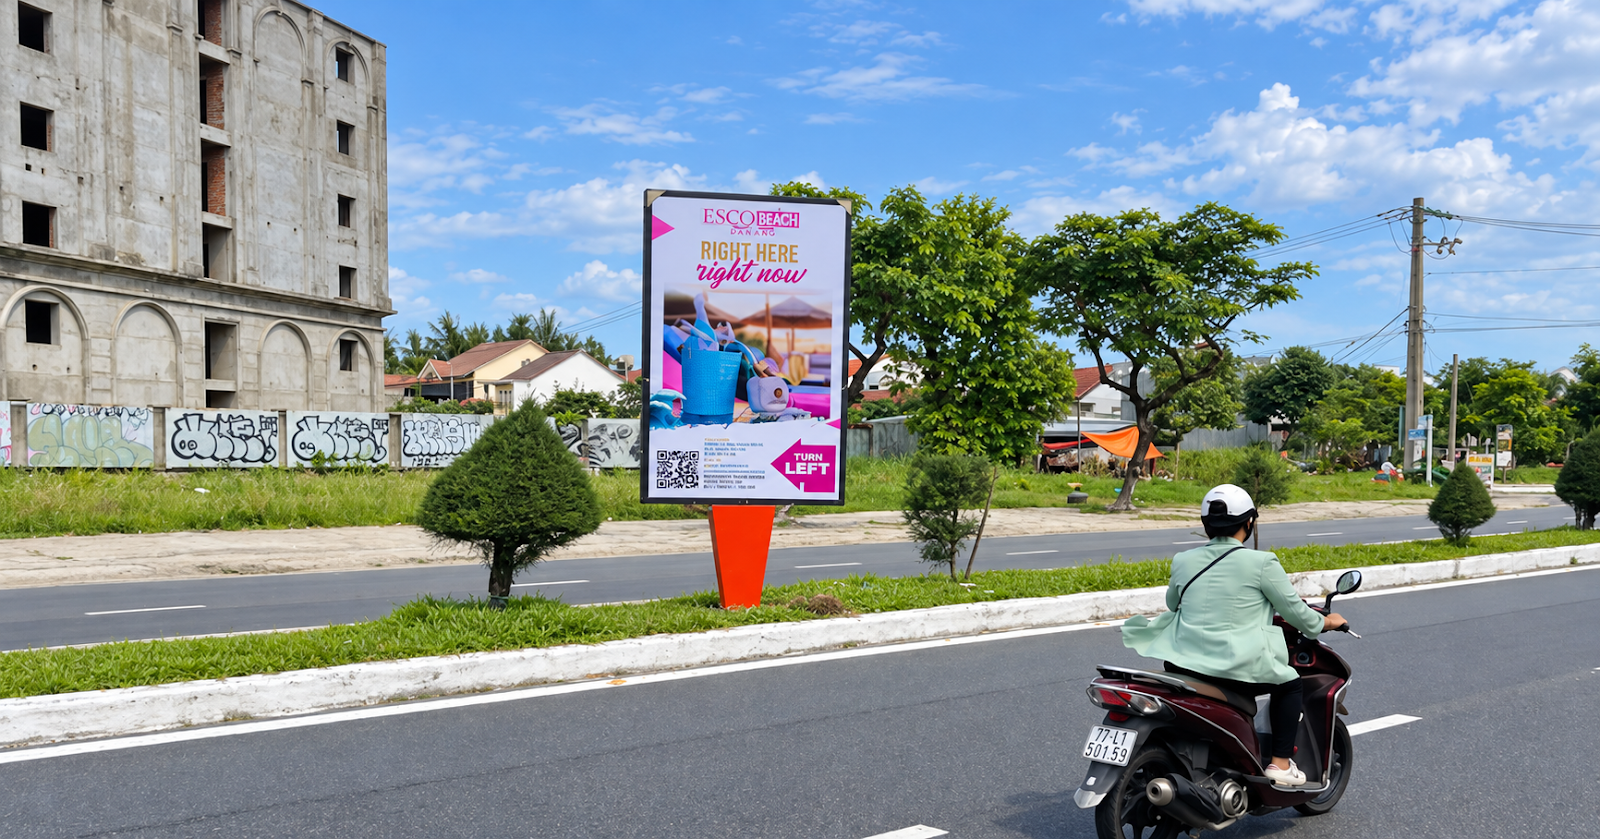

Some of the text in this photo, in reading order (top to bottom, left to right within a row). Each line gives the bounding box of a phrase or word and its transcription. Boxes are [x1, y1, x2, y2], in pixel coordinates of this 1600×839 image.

[703, 208, 798, 226] ESCO BEACH
[701, 241, 798, 263] RIGHT HERE
[696, 257, 807, 289] right now
[785, 453, 830, 474] TURN LEFT
[1095, 728, 1127, 745] 77-L1
[1085, 742, 1127, 762] 501.59
